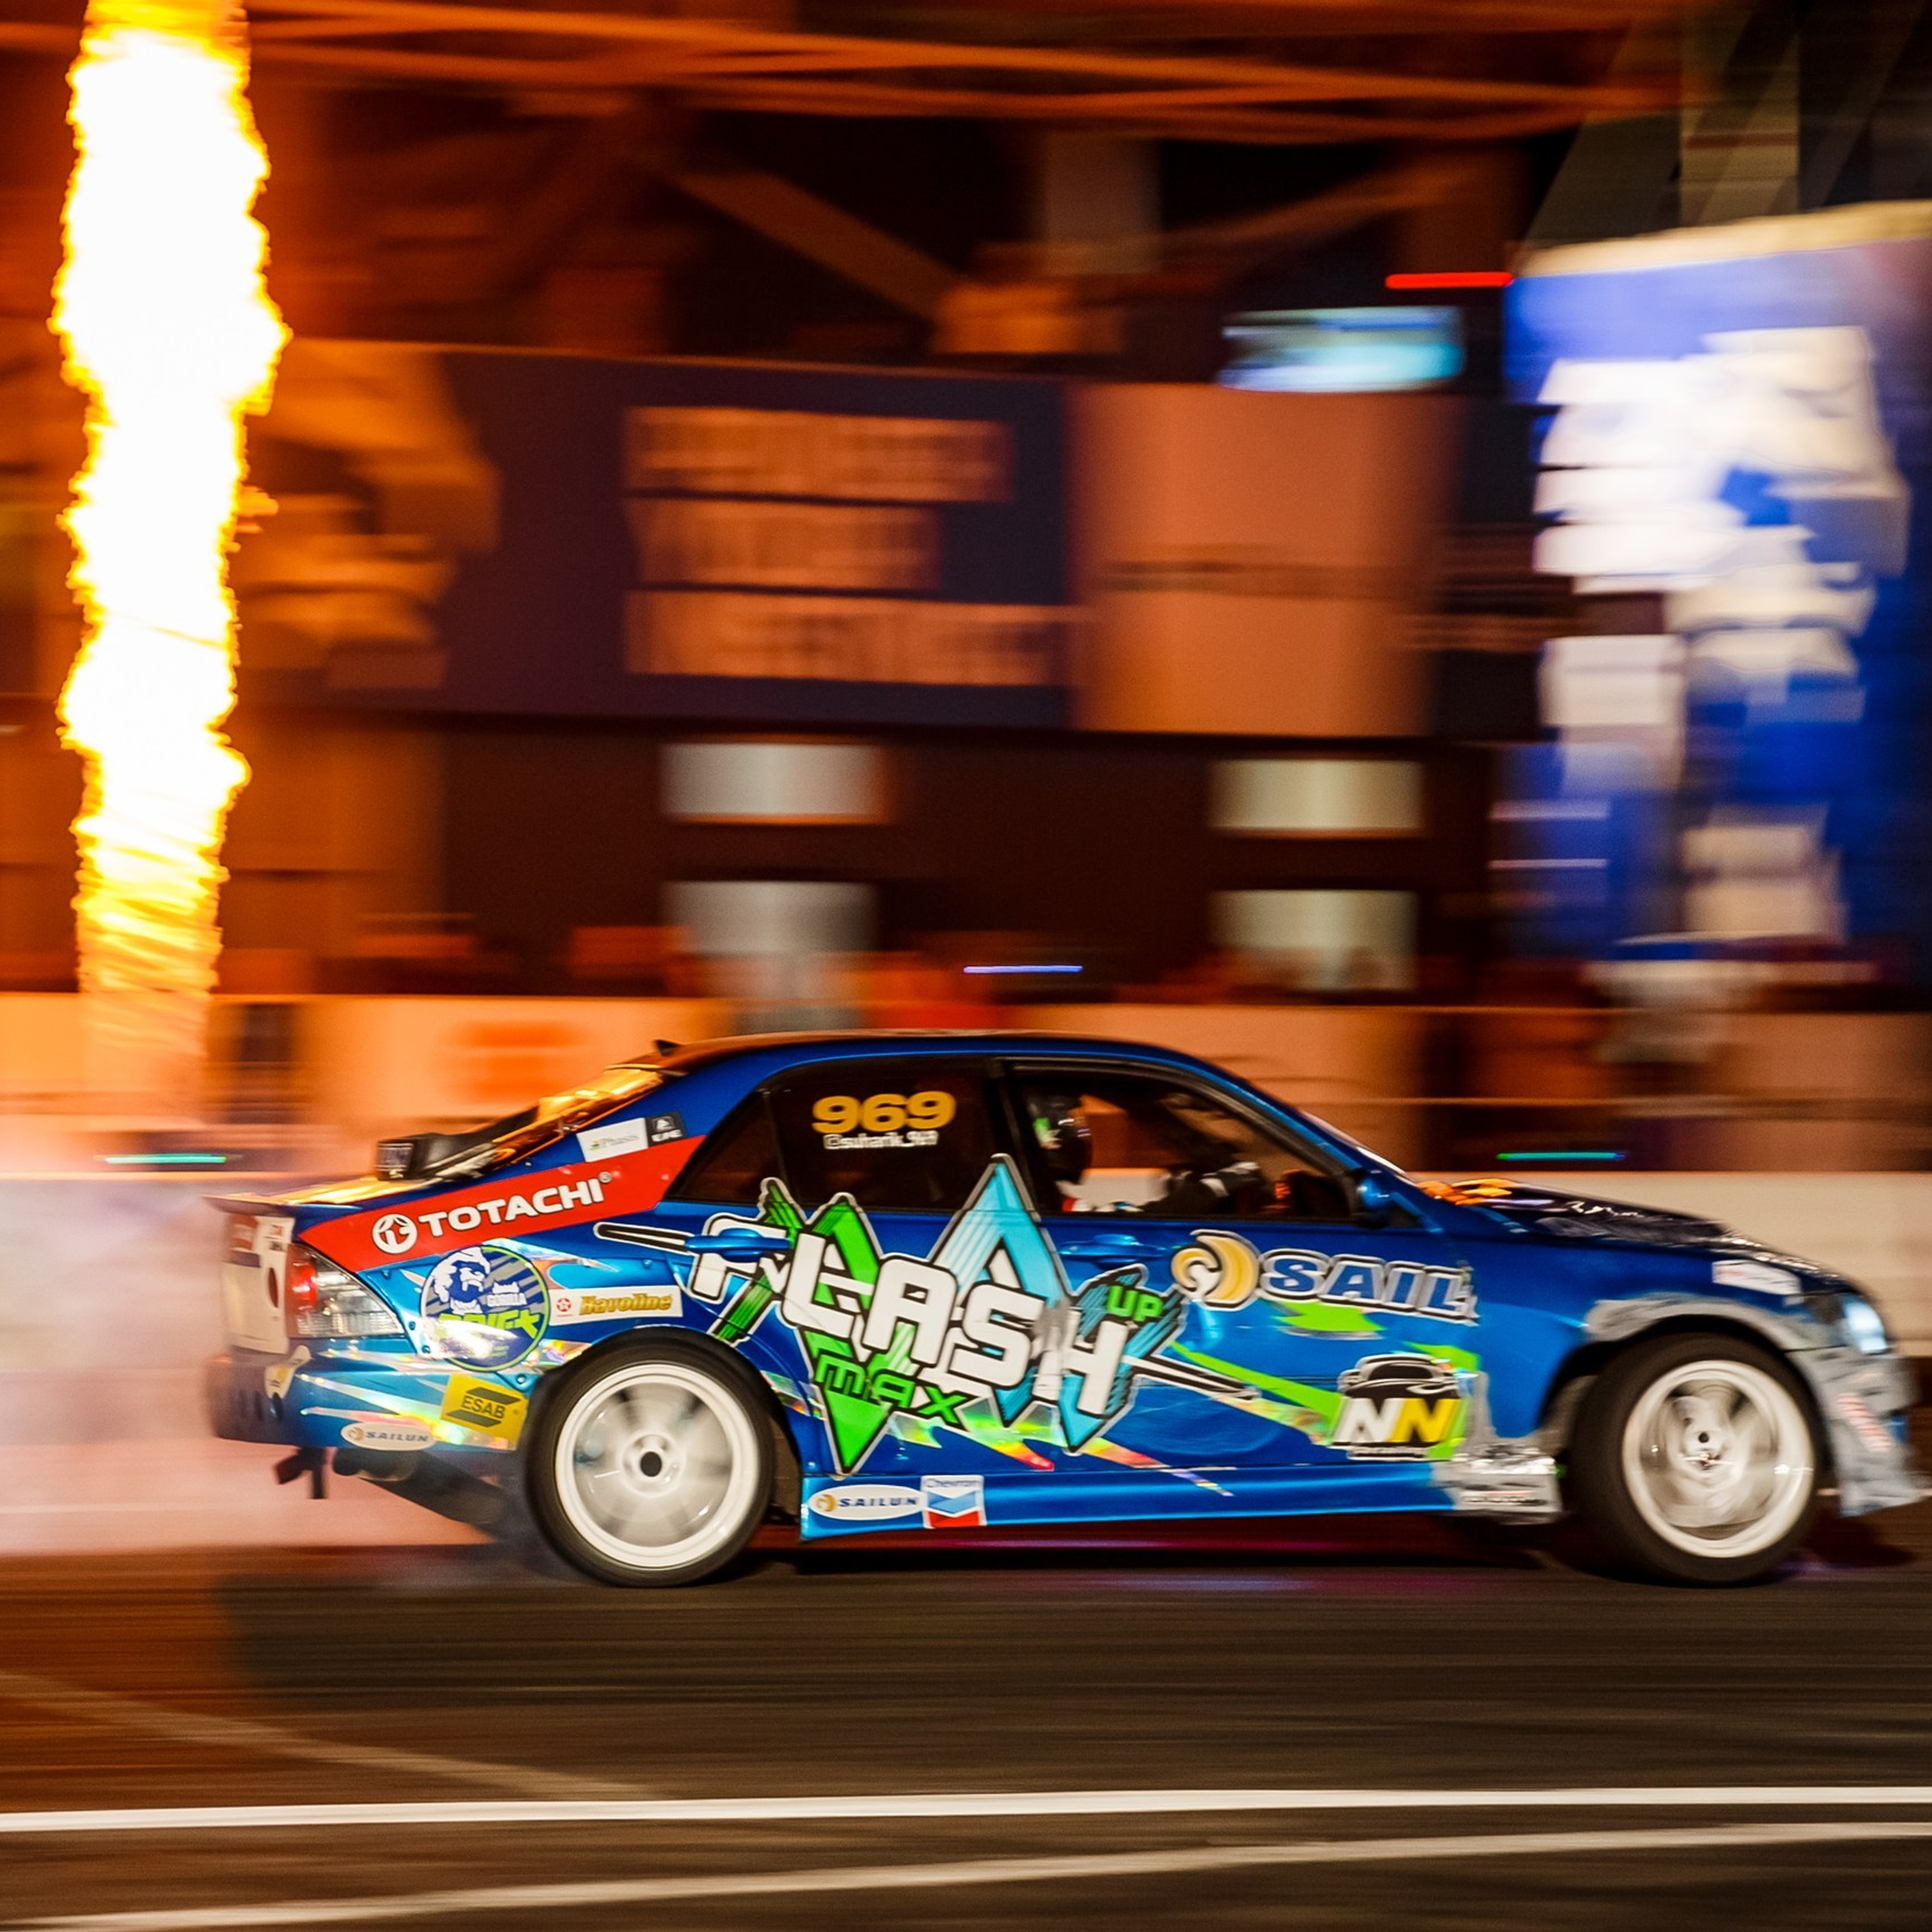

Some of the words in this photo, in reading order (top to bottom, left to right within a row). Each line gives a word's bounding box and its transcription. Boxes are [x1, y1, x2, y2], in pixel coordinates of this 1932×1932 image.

[812, 1091, 955, 1134] 969
[418, 1178, 604, 1238] TOTACHI
[579, 1293, 673, 1315] Havoline
[1108, 1283, 1164, 1320] UP
[438, 1308, 541, 1340] IFT
[461, 1395, 506, 1420] ESAB
[366, 1431, 429, 1442] SAILUN
[839, 1497, 918, 1508] SAILUN
